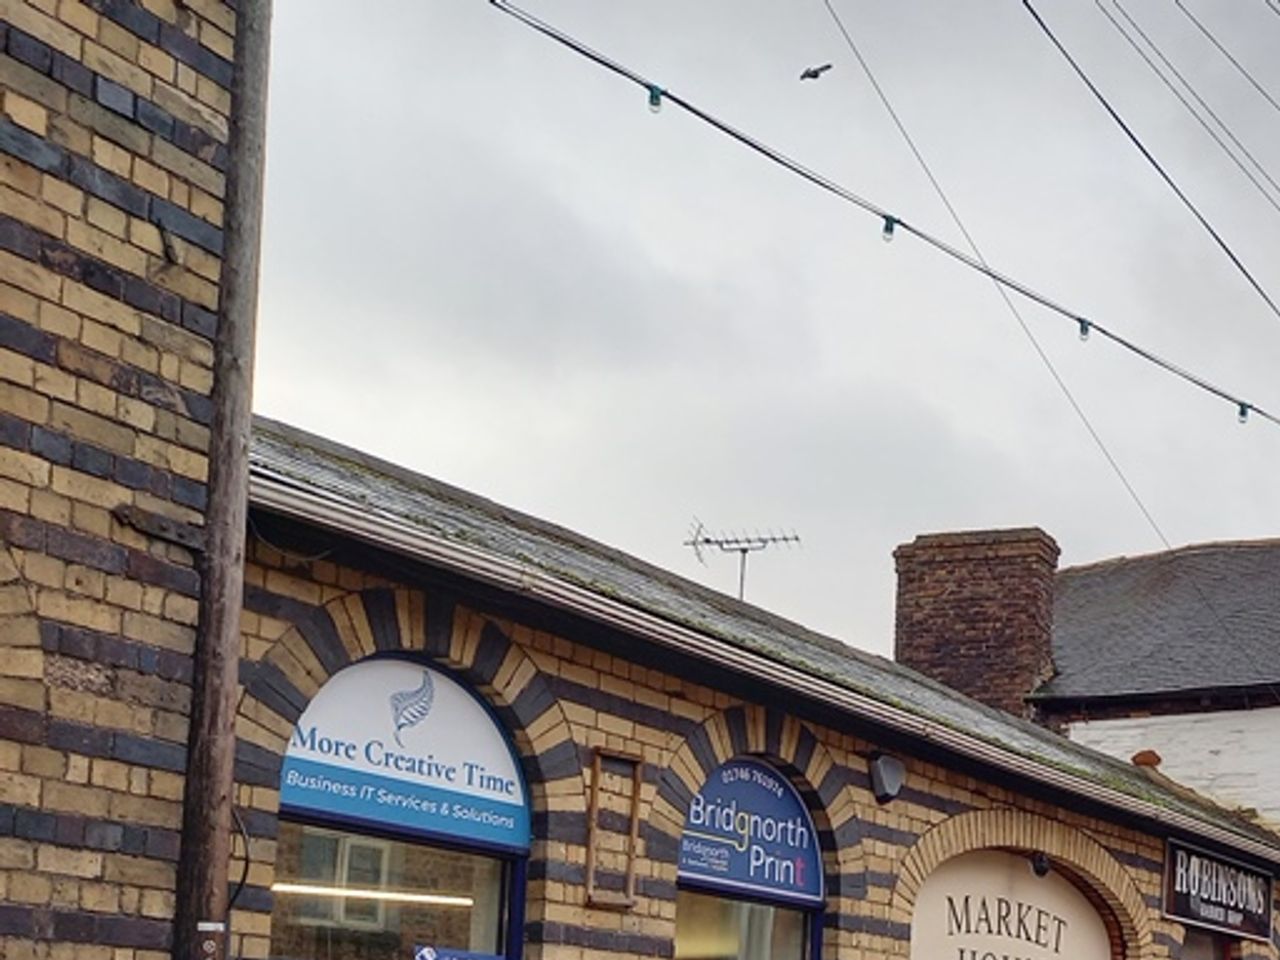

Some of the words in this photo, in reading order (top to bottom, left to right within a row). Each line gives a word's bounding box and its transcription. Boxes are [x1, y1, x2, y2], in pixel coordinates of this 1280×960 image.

[291, 723, 357, 759] More
[365, 740, 456, 782] Creative
[463, 762, 516, 796] Time
[286, 770, 357, 797] Business
[360, 784, 374, 799] IT
[377, 789, 438, 814] Services
[441, 802, 450, 816] &
[453, 804, 515, 829] Solutions
[690, 794, 809, 851] Bridgnorth
[750, 845, 806, 886] Print
[1174, 849, 1265, 914] ROBINSONS
[945, 895, 1068, 954] MARKET
